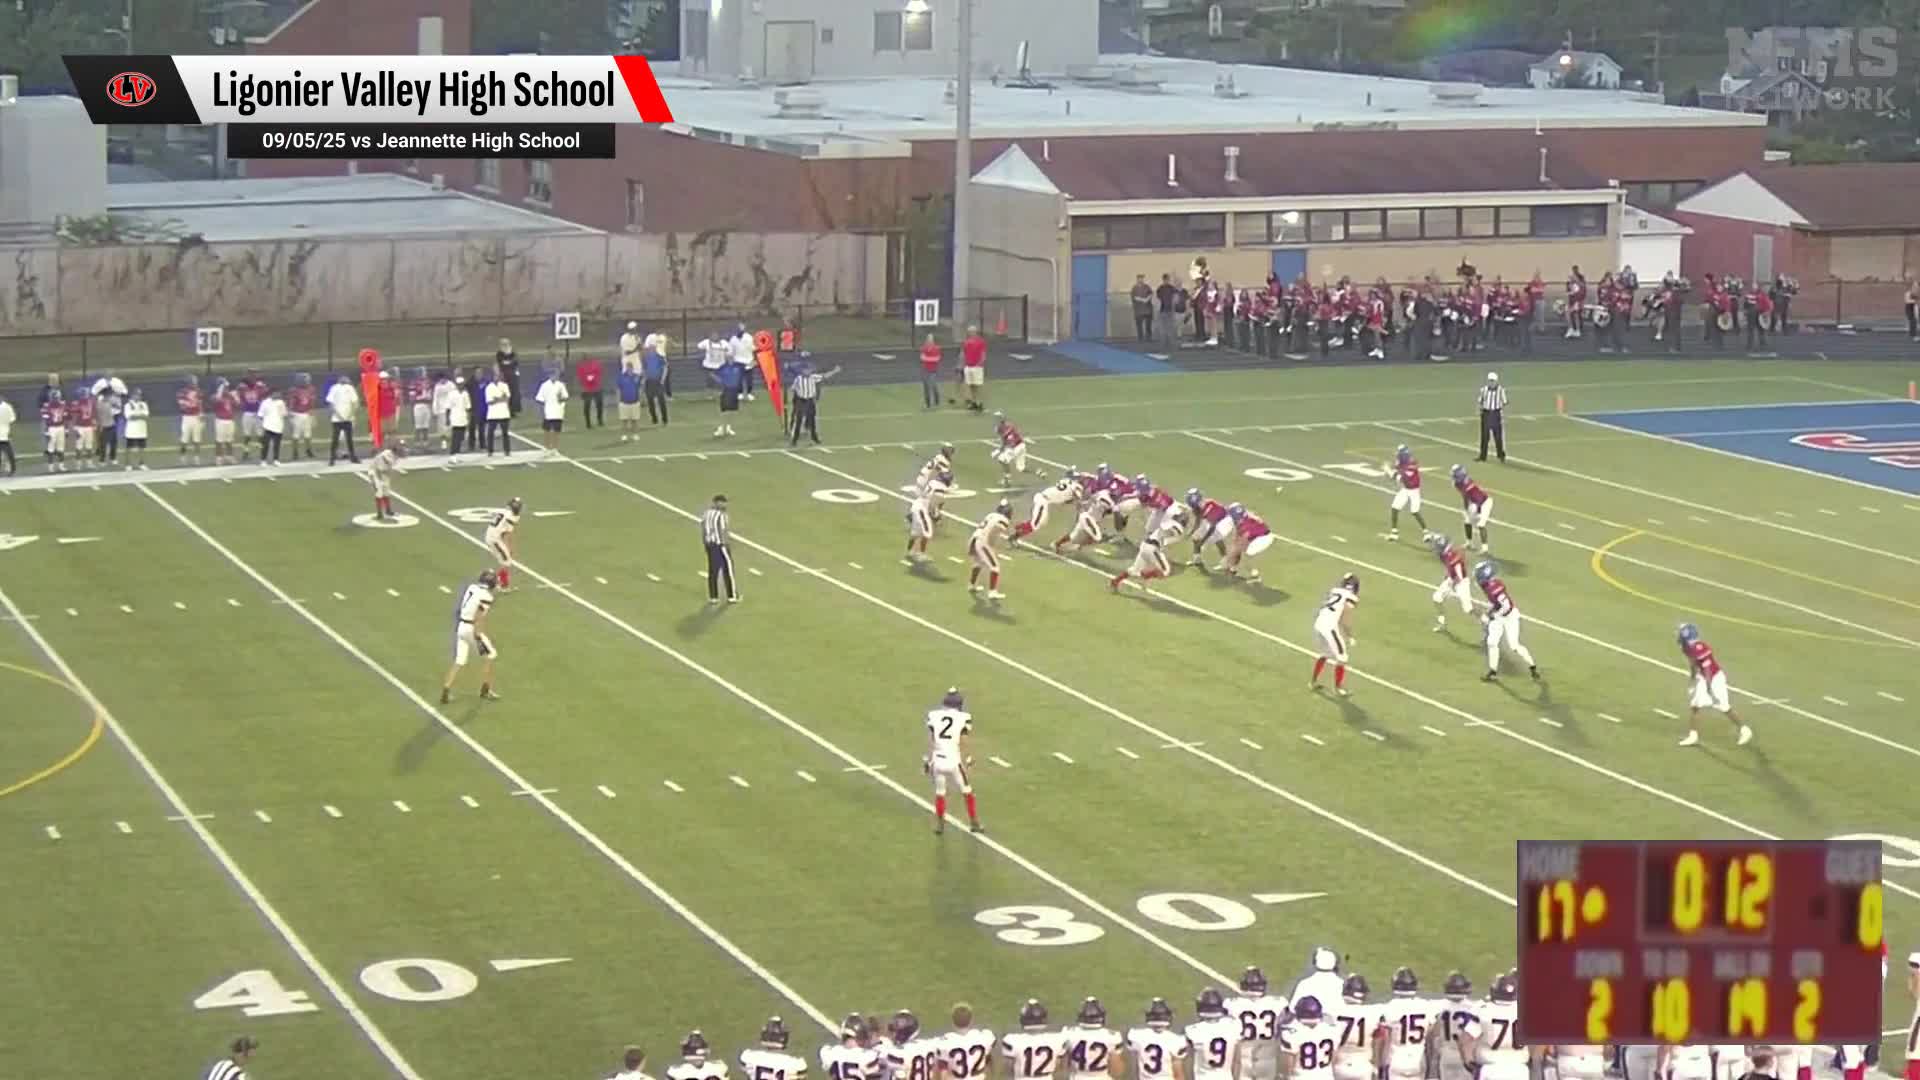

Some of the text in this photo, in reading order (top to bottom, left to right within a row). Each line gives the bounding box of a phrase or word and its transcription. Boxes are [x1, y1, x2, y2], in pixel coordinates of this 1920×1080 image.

[558, 316, 578, 335] 20
[918, 303, 935, 321] 10
[199, 331, 220, 350] 30
[939, 716, 954, 740] 2
[973, 892, 1257, 946] 30
[194, 957, 479, 1017] 40
[1239, 1010, 1277, 1041] 63
[1337, 1015, 1366, 1048] 71
[1400, 1013, 1426, 1045] 15
[949, 1044, 987, 1079] 32
[1023, 1045, 1054, 1077] 12
[1072, 1039, 1109, 1072] 42
[1144, 1043, 1163, 1075] 3
[1209, 1036, 1227, 1068] 9
[1300, 1037, 1334, 1070] 83
